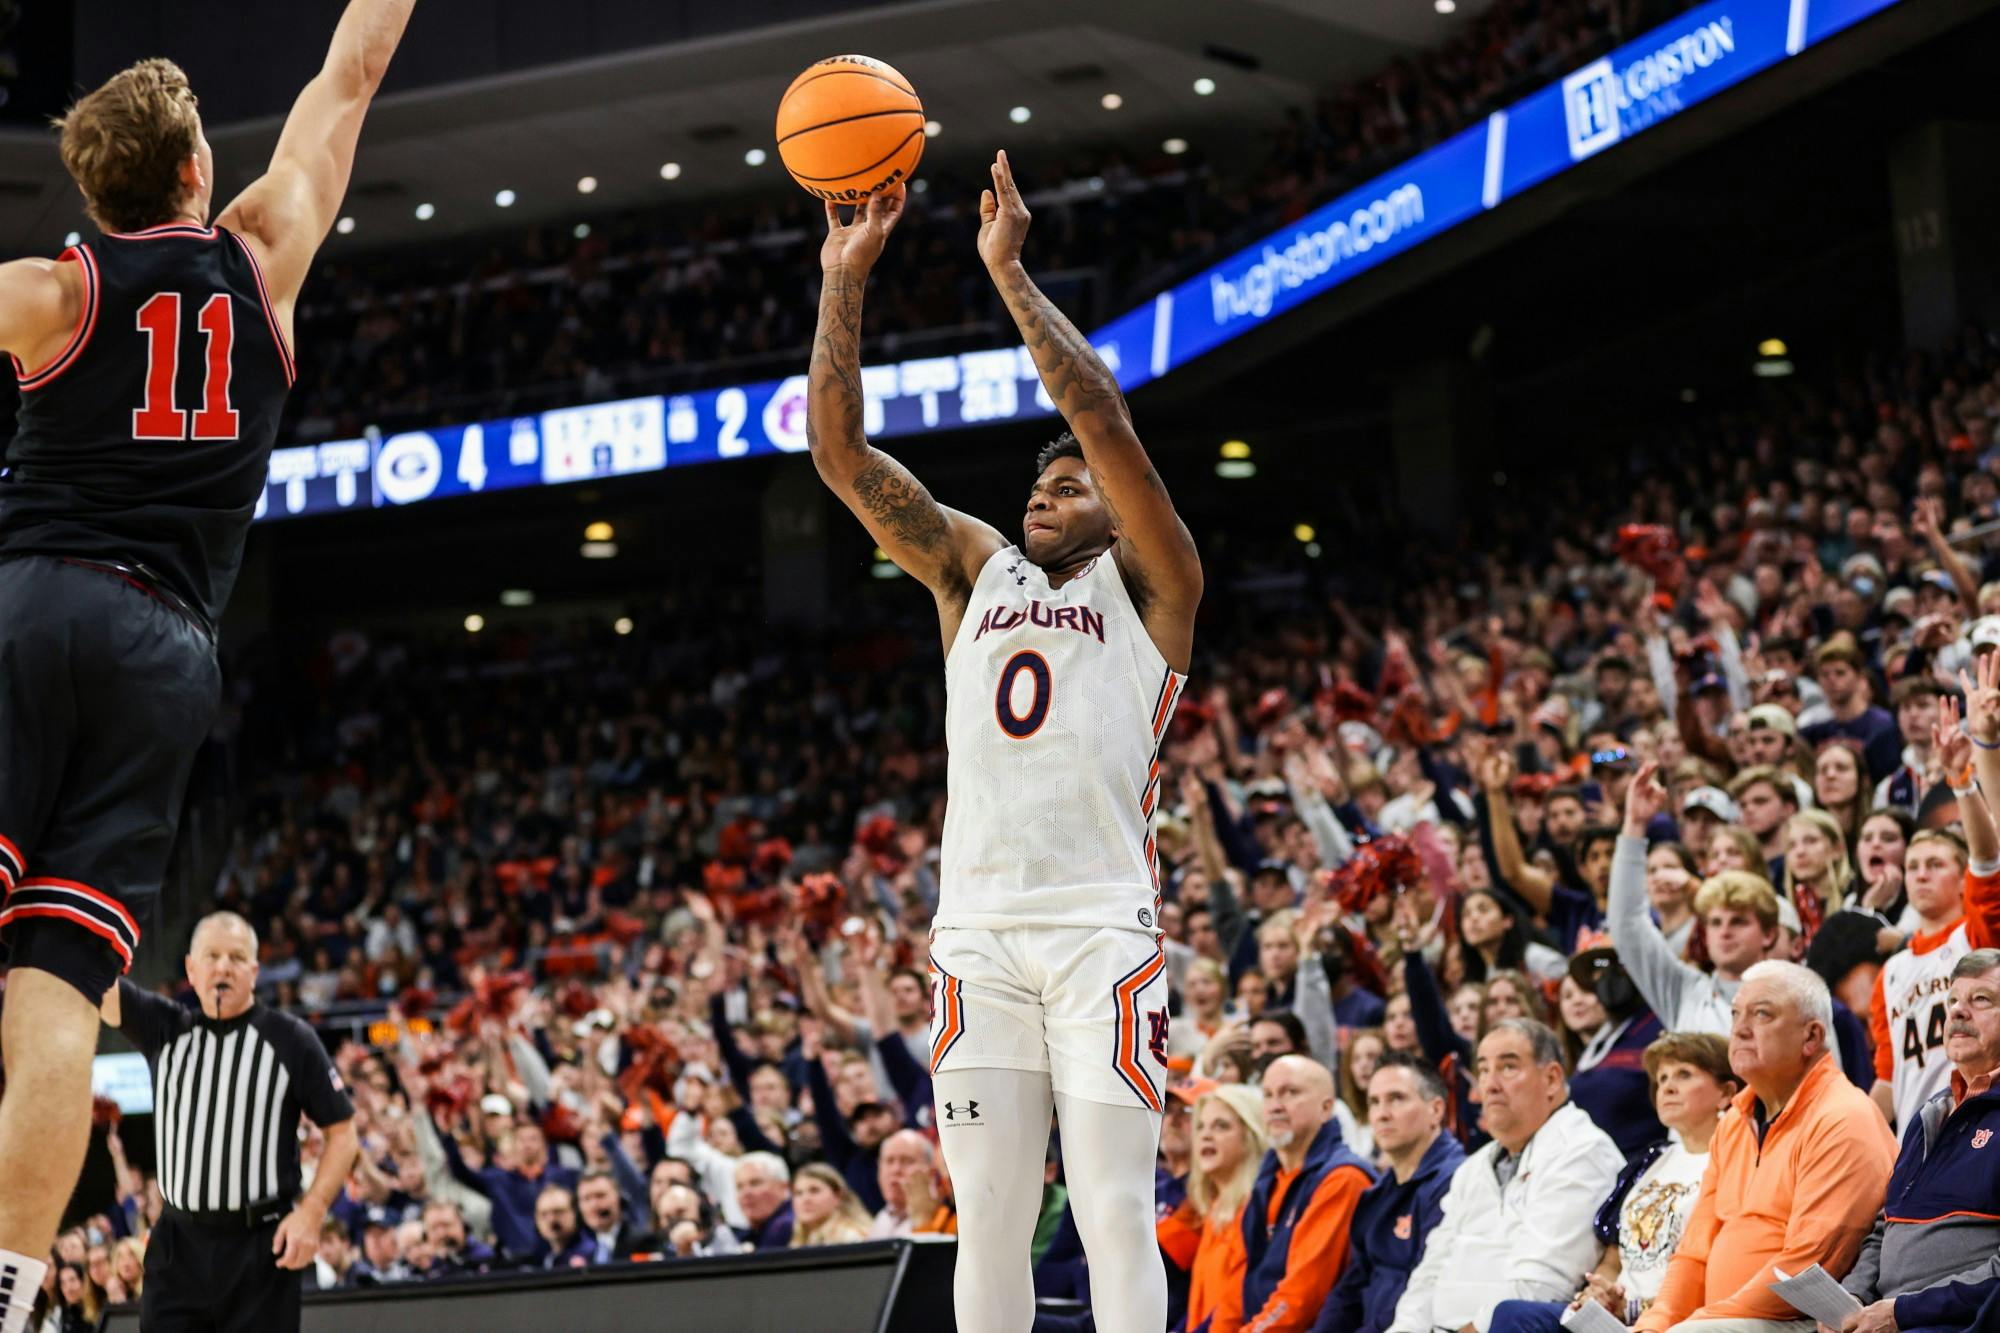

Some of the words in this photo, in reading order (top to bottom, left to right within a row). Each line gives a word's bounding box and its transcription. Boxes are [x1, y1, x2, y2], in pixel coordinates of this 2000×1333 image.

[804, 169, 903, 201] Wilson
[1211, 183, 1425, 324] hughston.com
[133, 292, 239, 440] 11
[457, 423, 487, 491] 4
[715, 387, 750, 458] 2
[995, 649, 1053, 739] 0
[1904, 1002, 1947, 1069] 44
